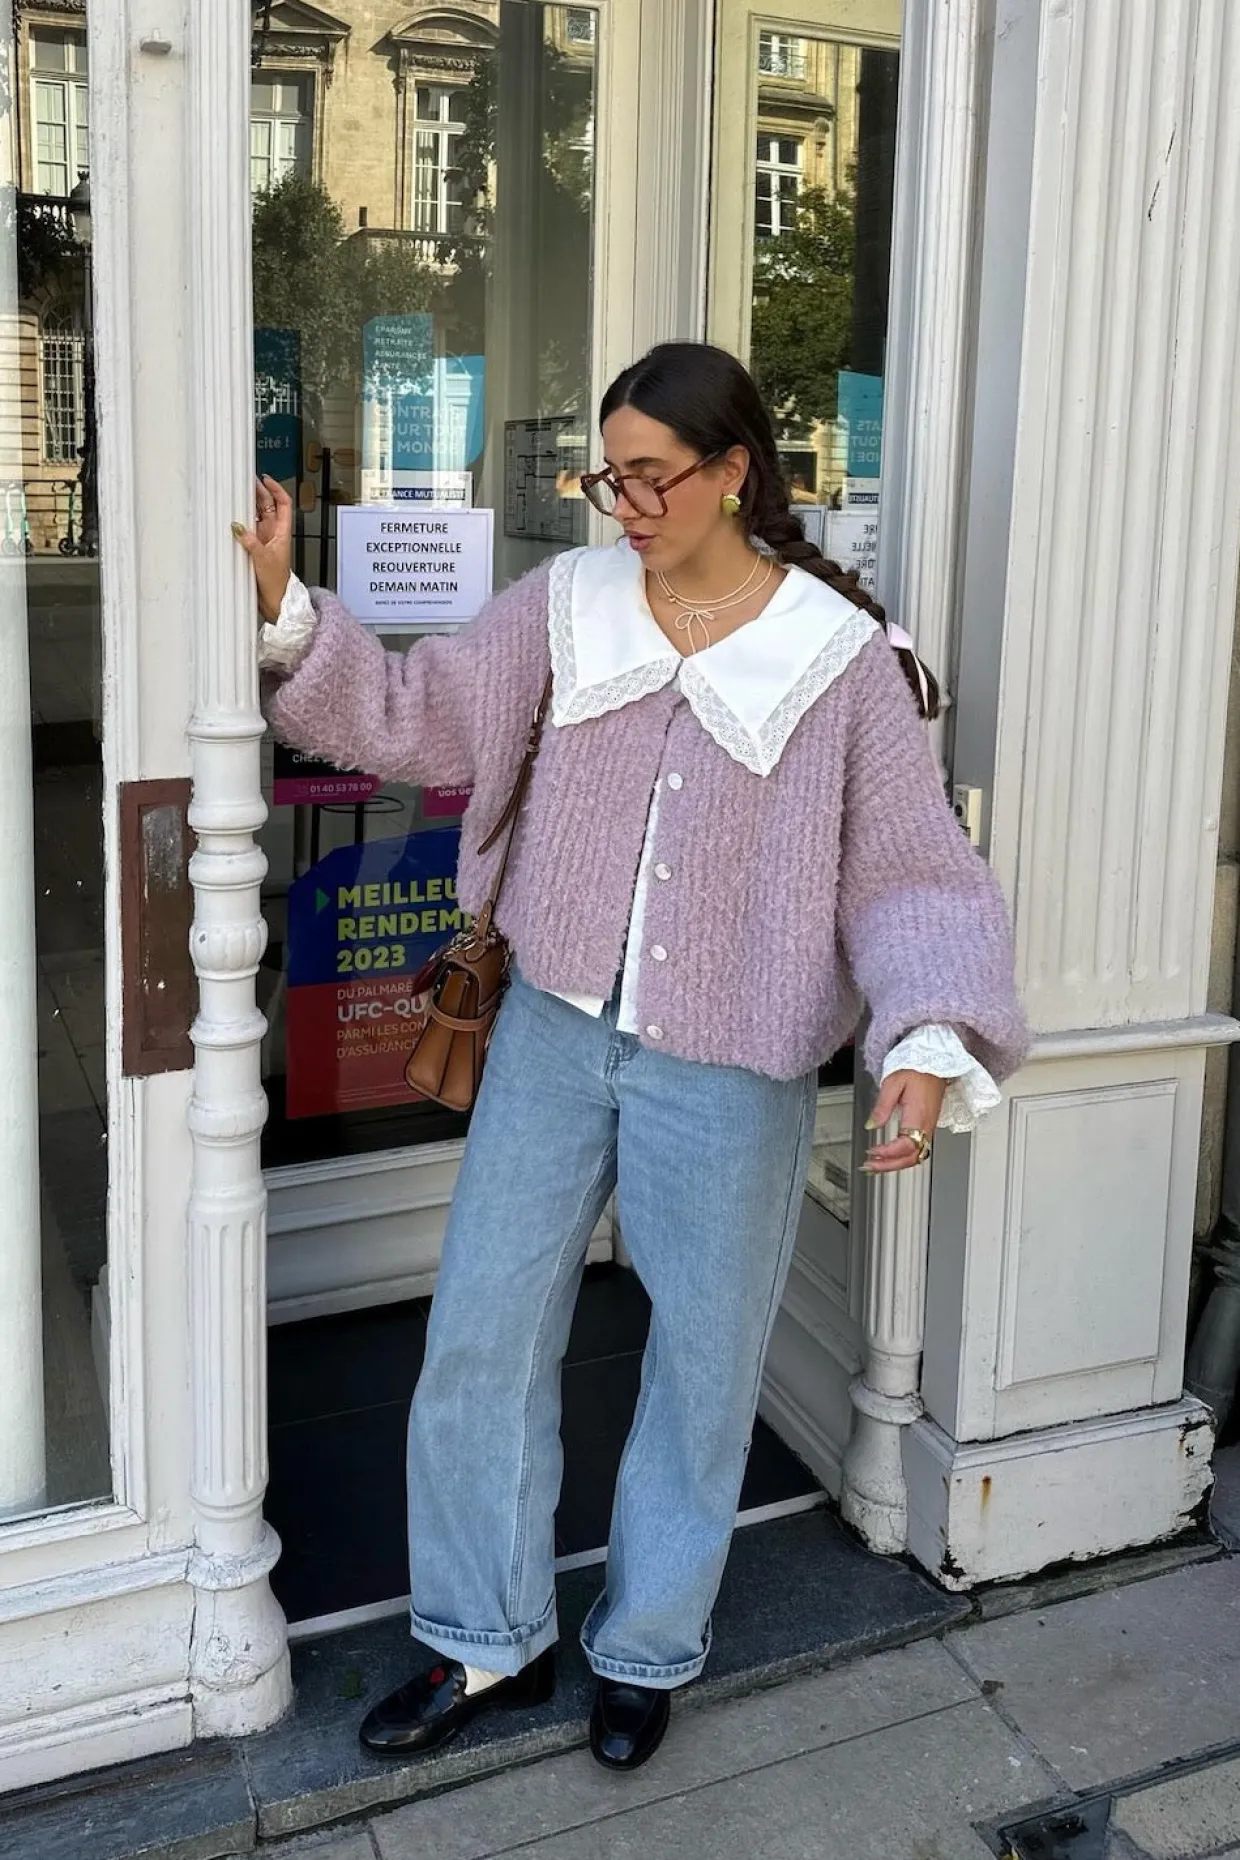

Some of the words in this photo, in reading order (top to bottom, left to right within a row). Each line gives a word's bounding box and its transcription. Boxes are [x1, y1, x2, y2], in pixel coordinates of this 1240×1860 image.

[380, 522, 448, 533] FERMETURE
[366, 542, 462, 553] EXCEPTIONNELLE
[372, 562, 455, 573] REOUVERTURE
[370, 581, 416, 592] DEMAIN
[420, 581, 458, 592] MATIN
[310, 785, 320, 793] 01
[322, 784, 335, 792] 40
[338, 877, 458, 909] MEILLEU
[336, 944, 406, 973] 2023
[337, 988, 355, 1000] DU
[337, 994, 427, 1022] UFC-QU
[337, 1026, 374, 1041] PARMI
[377, 1023, 399, 1036] LES
